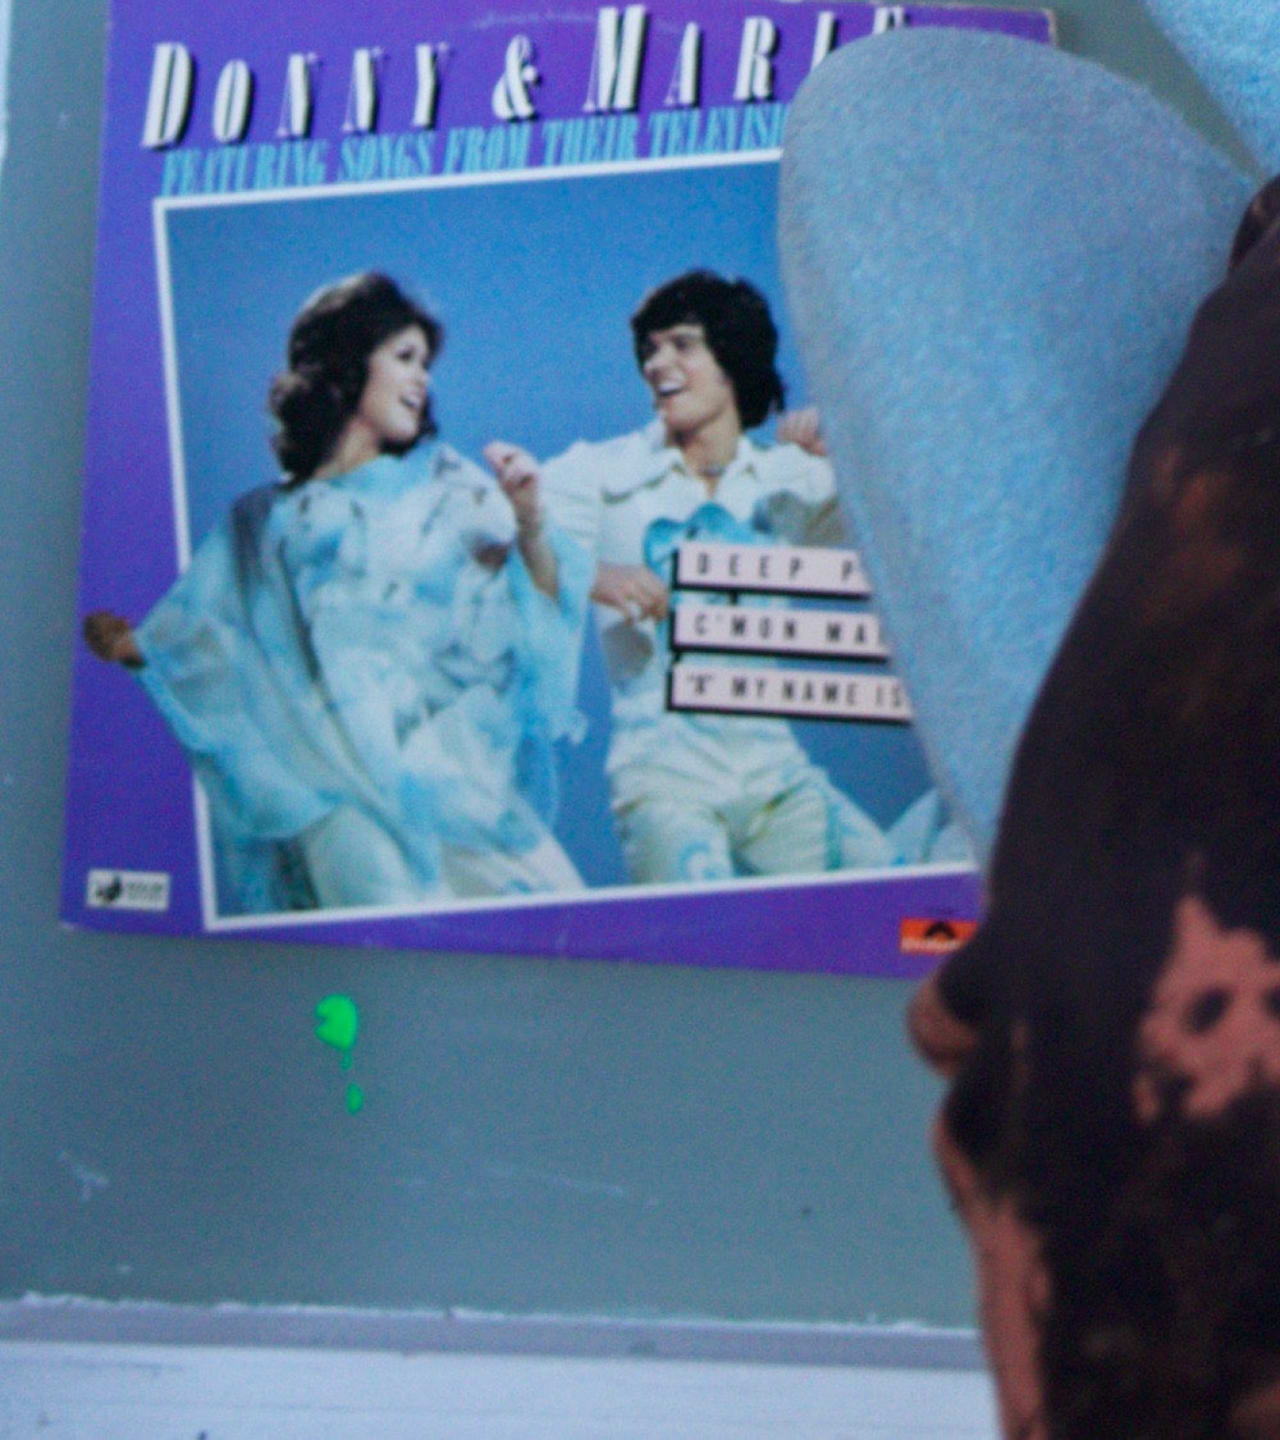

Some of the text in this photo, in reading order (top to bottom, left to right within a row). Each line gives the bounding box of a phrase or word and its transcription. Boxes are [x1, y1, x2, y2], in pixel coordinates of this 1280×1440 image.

[142, 41, 452, 148] DONNY
[492, 34, 538, 121] &
[161, 139, 328, 198] FEATURING
[337, 132, 437, 182] SONGS
[443, 123, 532, 176] FROM
[542, 114, 638, 167] THEIR
[697, 552, 801, 579] DEEP
[732, 677, 764, 698] MY
[784, 679, 857, 706] NAME
